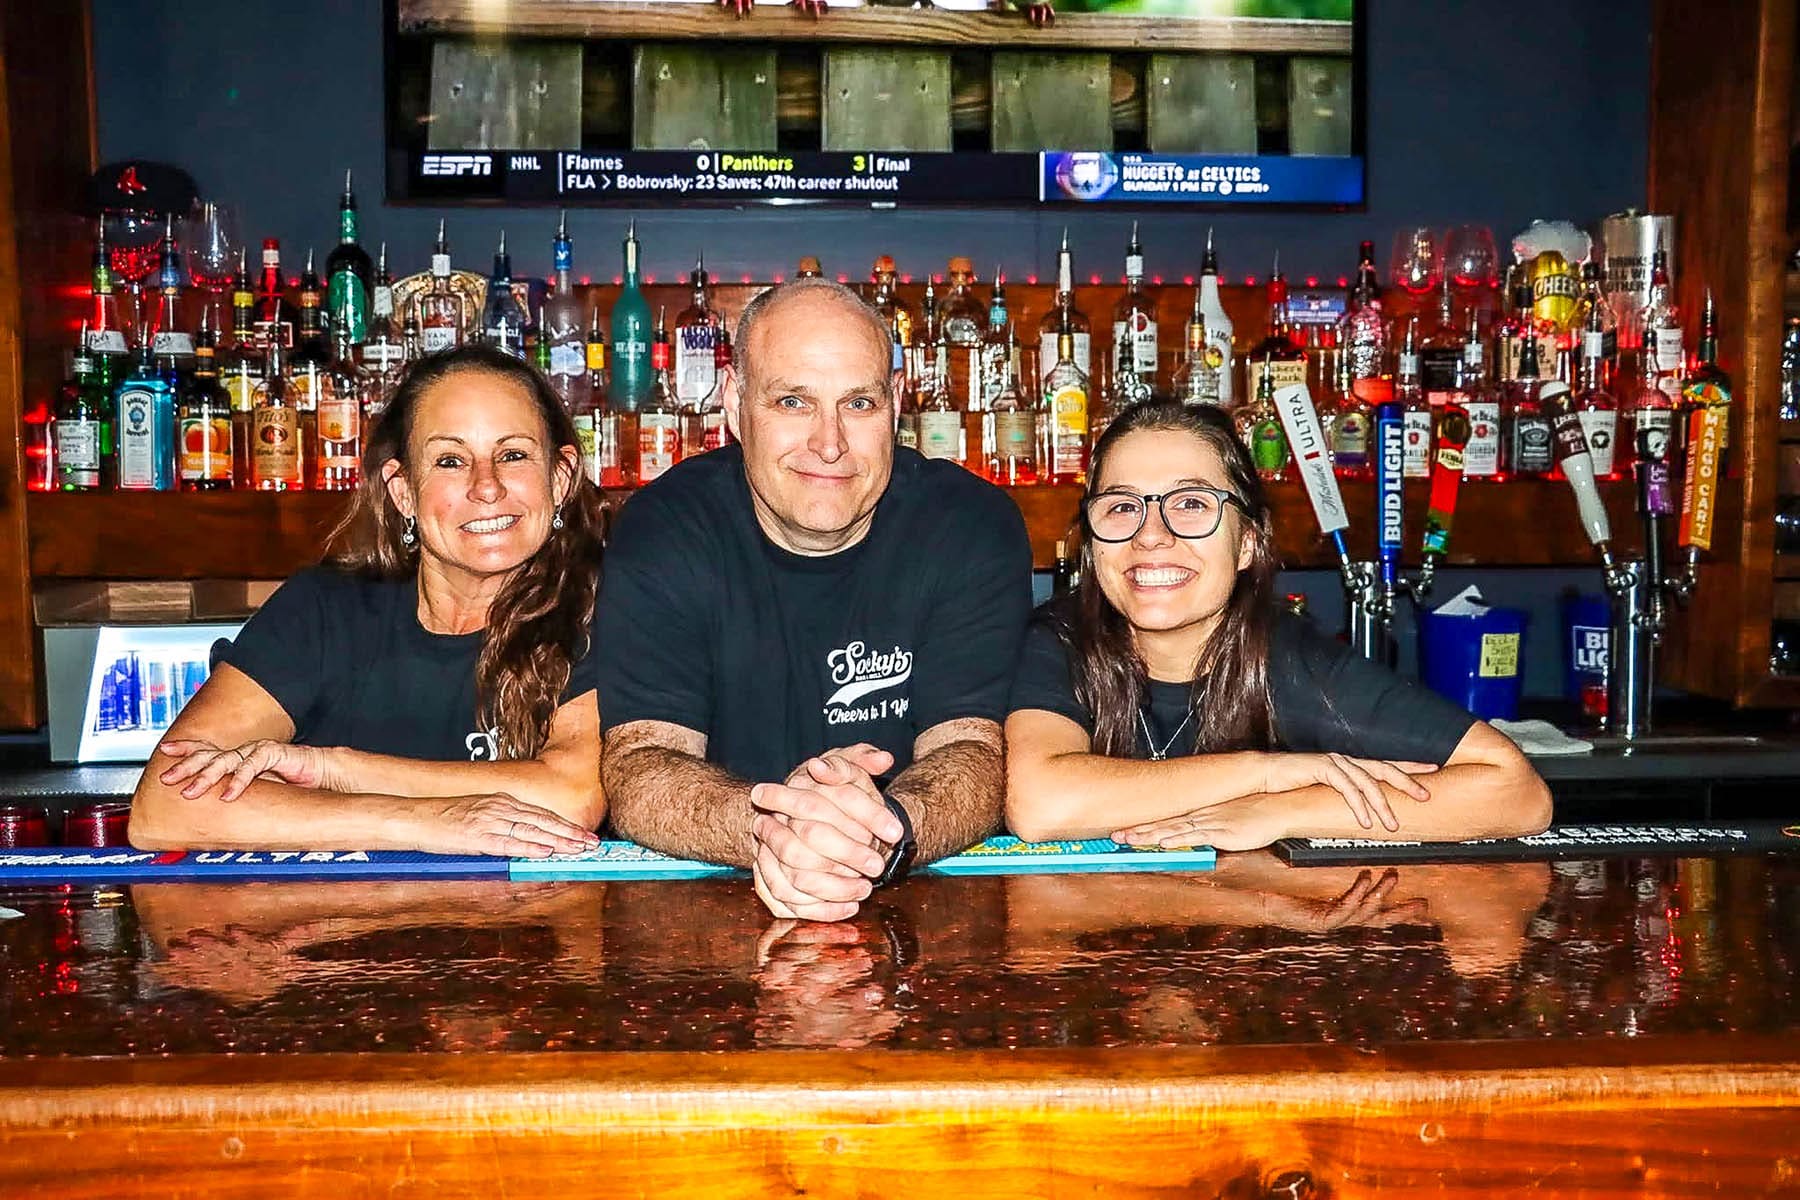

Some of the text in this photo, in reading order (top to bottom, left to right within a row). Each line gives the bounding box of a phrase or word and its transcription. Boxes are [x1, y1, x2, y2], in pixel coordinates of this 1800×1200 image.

[423, 156, 492, 175] ESPN
[511, 156, 541, 170] NHL
[566, 155, 910, 171] Flames 0 Panthers 3 Final
[1122, 166, 1184, 180] NUGGETS
[1201, 166, 1261, 181] CELTICS
[567, 174, 596, 189] FLA
[617, 174, 693, 192] Bobrovsky:
[695, 175, 714, 189] 23
[763, 175, 796, 189] 47th
[798, 176, 842, 189] career
[845, 175, 899, 190] shutout
[1122, 181, 1171, 192] SUNDAY
[682, 325, 717, 338] ABSOLU
[1289, 393, 1315, 449] ULTRA
[1695, 412, 1718, 535] MANGO CART
[1384, 424, 1402, 542] BUD LIGHT
[880, 699, 887, 718] 1
[195, 850, 371, 864] ULTRA
